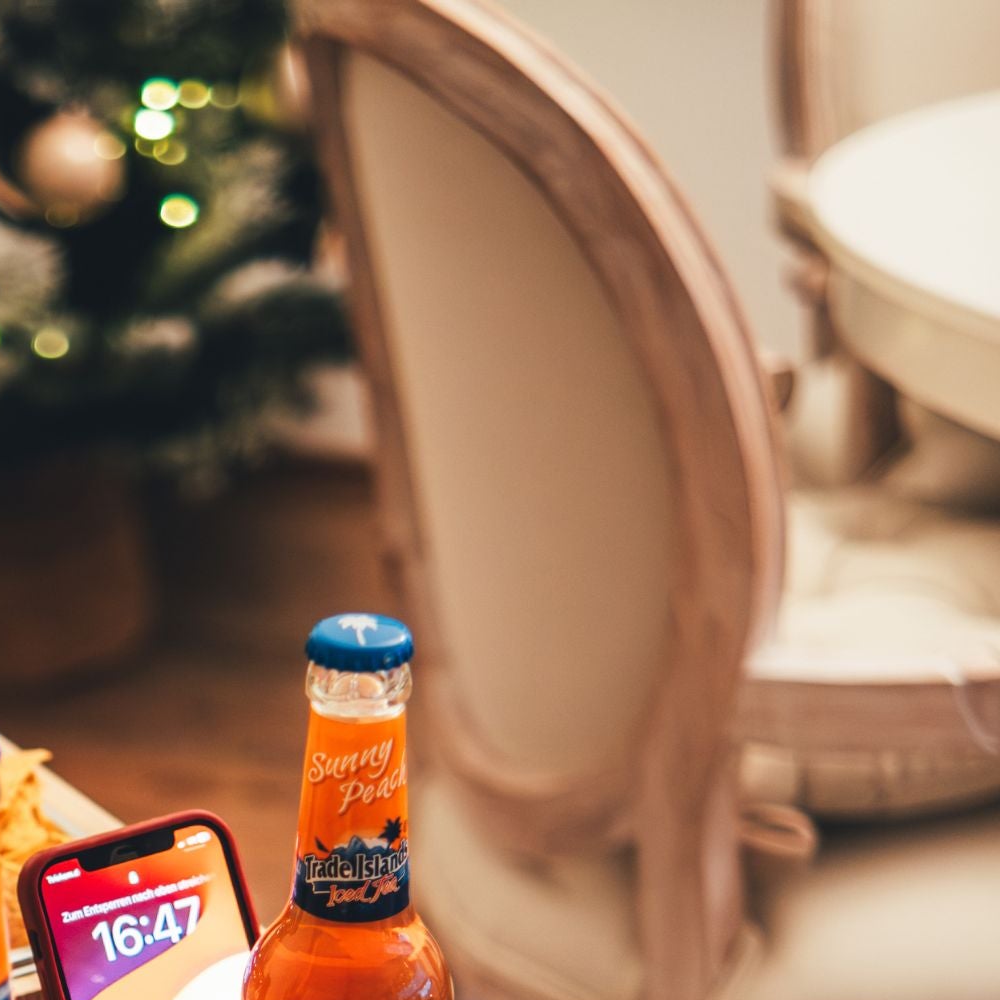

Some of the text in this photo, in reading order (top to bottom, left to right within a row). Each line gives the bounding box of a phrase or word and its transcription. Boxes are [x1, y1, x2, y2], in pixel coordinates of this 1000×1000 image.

[308, 737, 393, 783] Sunny
[60, 910, 84, 923] Zum
[83, 896, 132, 917] Entsperren
[92, 895, 201, 963] 16:47
